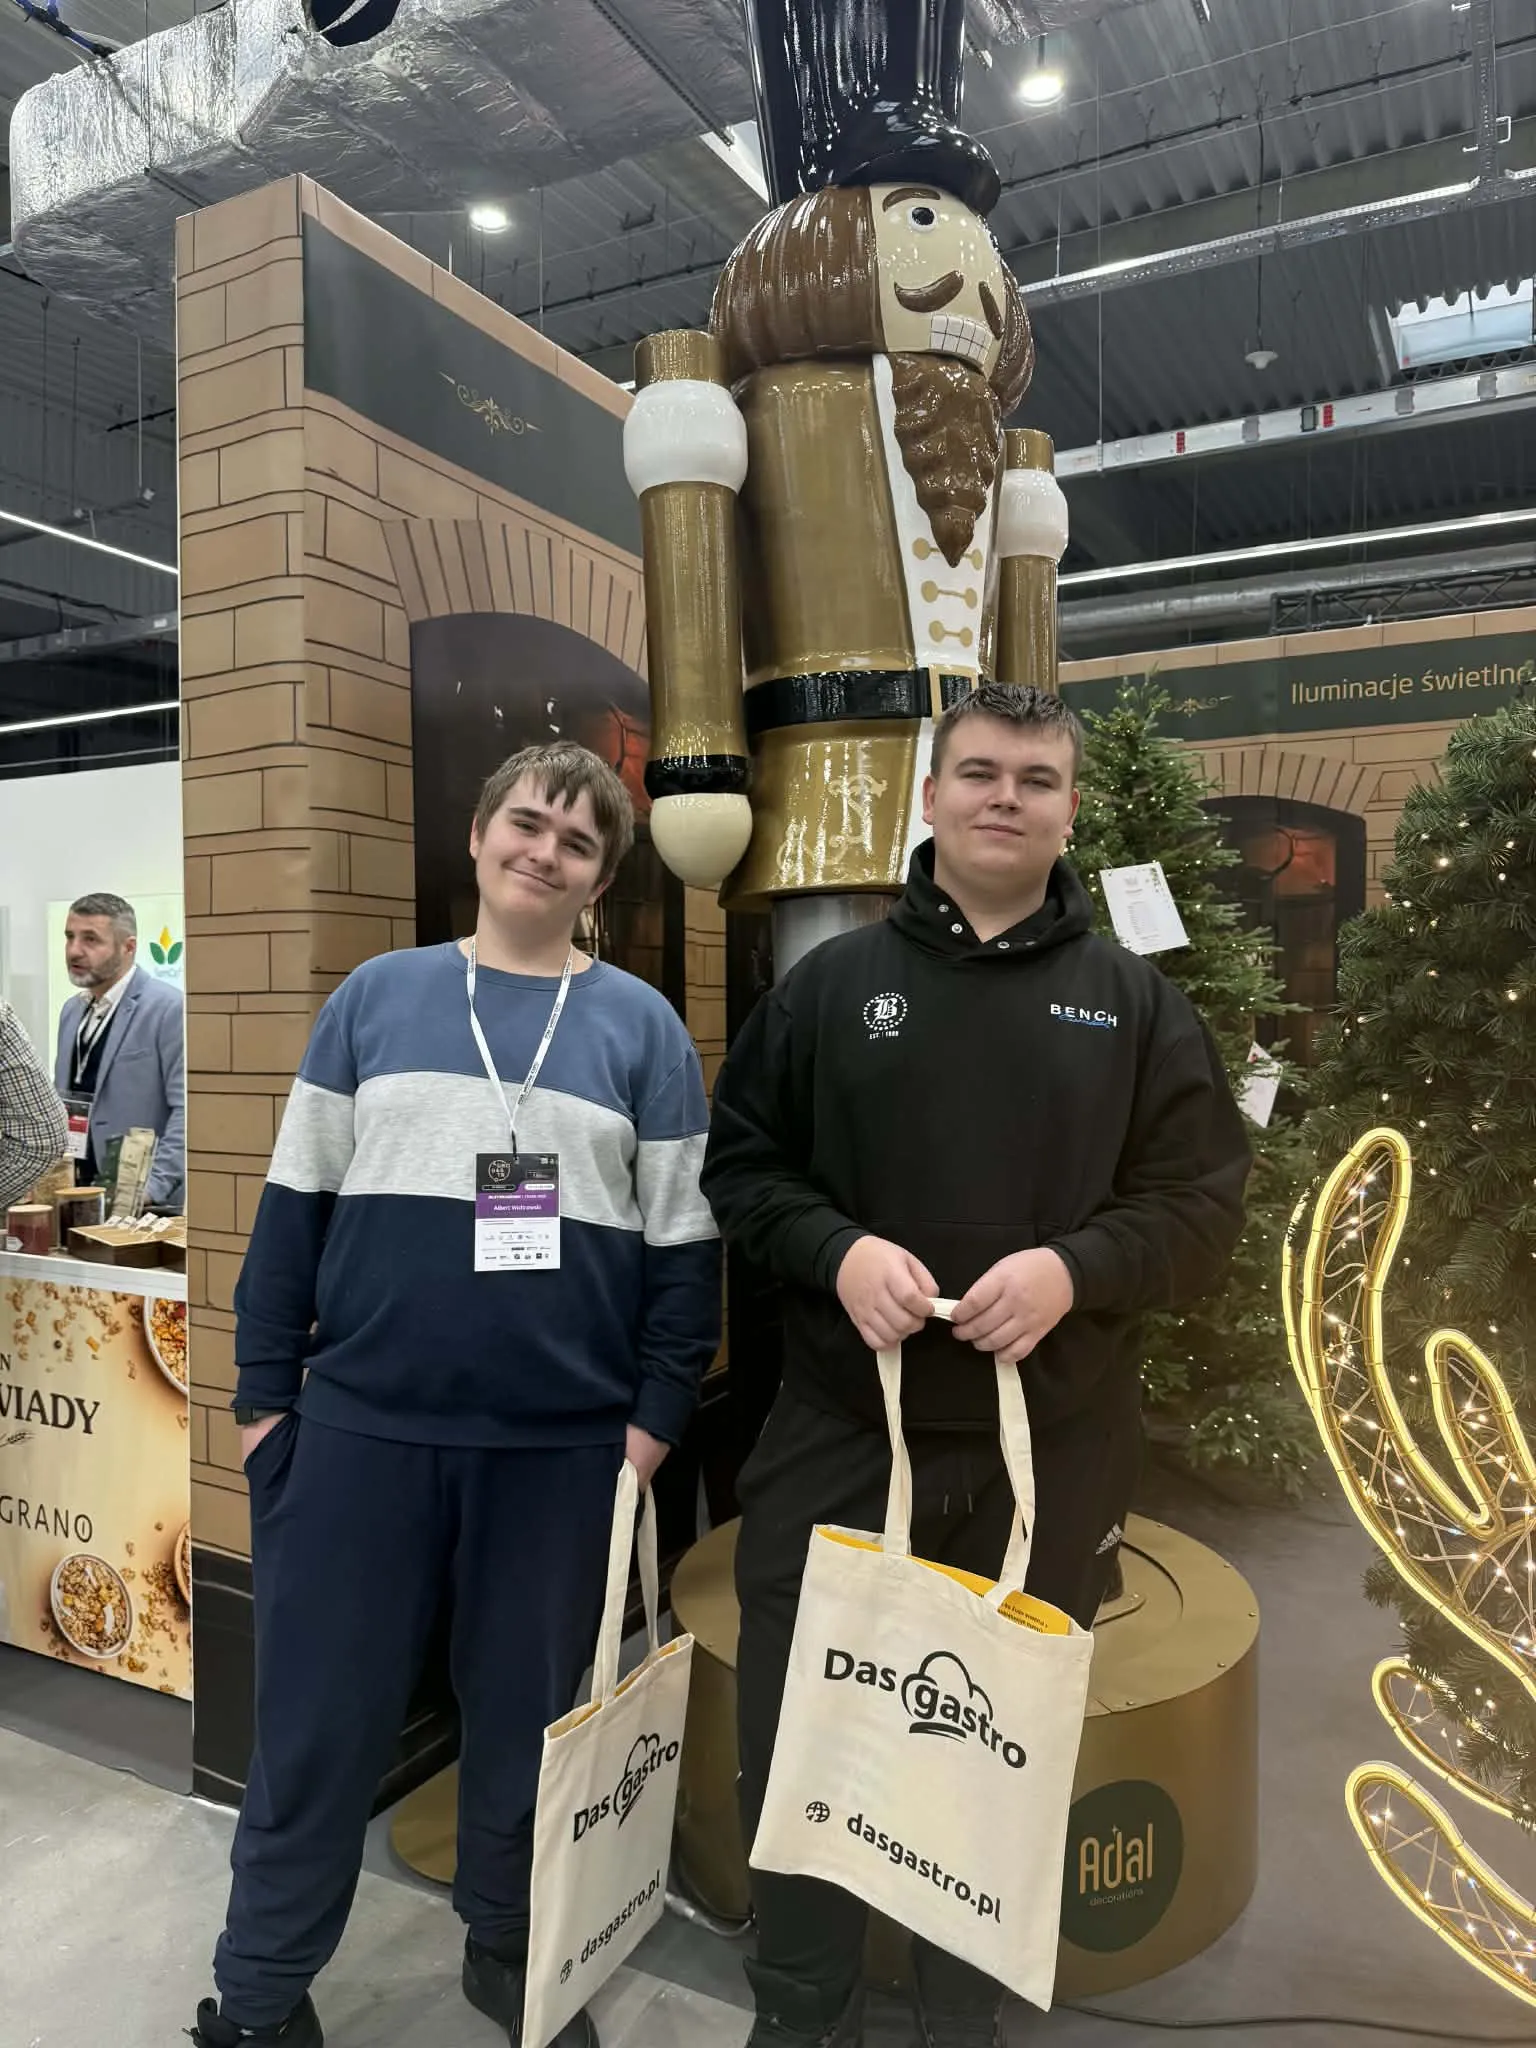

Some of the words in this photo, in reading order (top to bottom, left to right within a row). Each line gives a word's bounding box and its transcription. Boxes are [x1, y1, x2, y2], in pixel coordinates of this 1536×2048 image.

[1291, 672, 1413, 704] Iluminacje
[1050, 1003, 1118, 1027] BENCH
[823, 1647, 897, 1692] Das
[913, 1683, 1027, 1769] gastro
[573, 1794, 610, 1842] Das
[621, 1740, 679, 1811] gastro
[847, 1814, 1001, 1924] dasgastro.pl
[1079, 1823, 1153, 1895] Adal
[580, 1869, 660, 1965] dasgastro.pl
